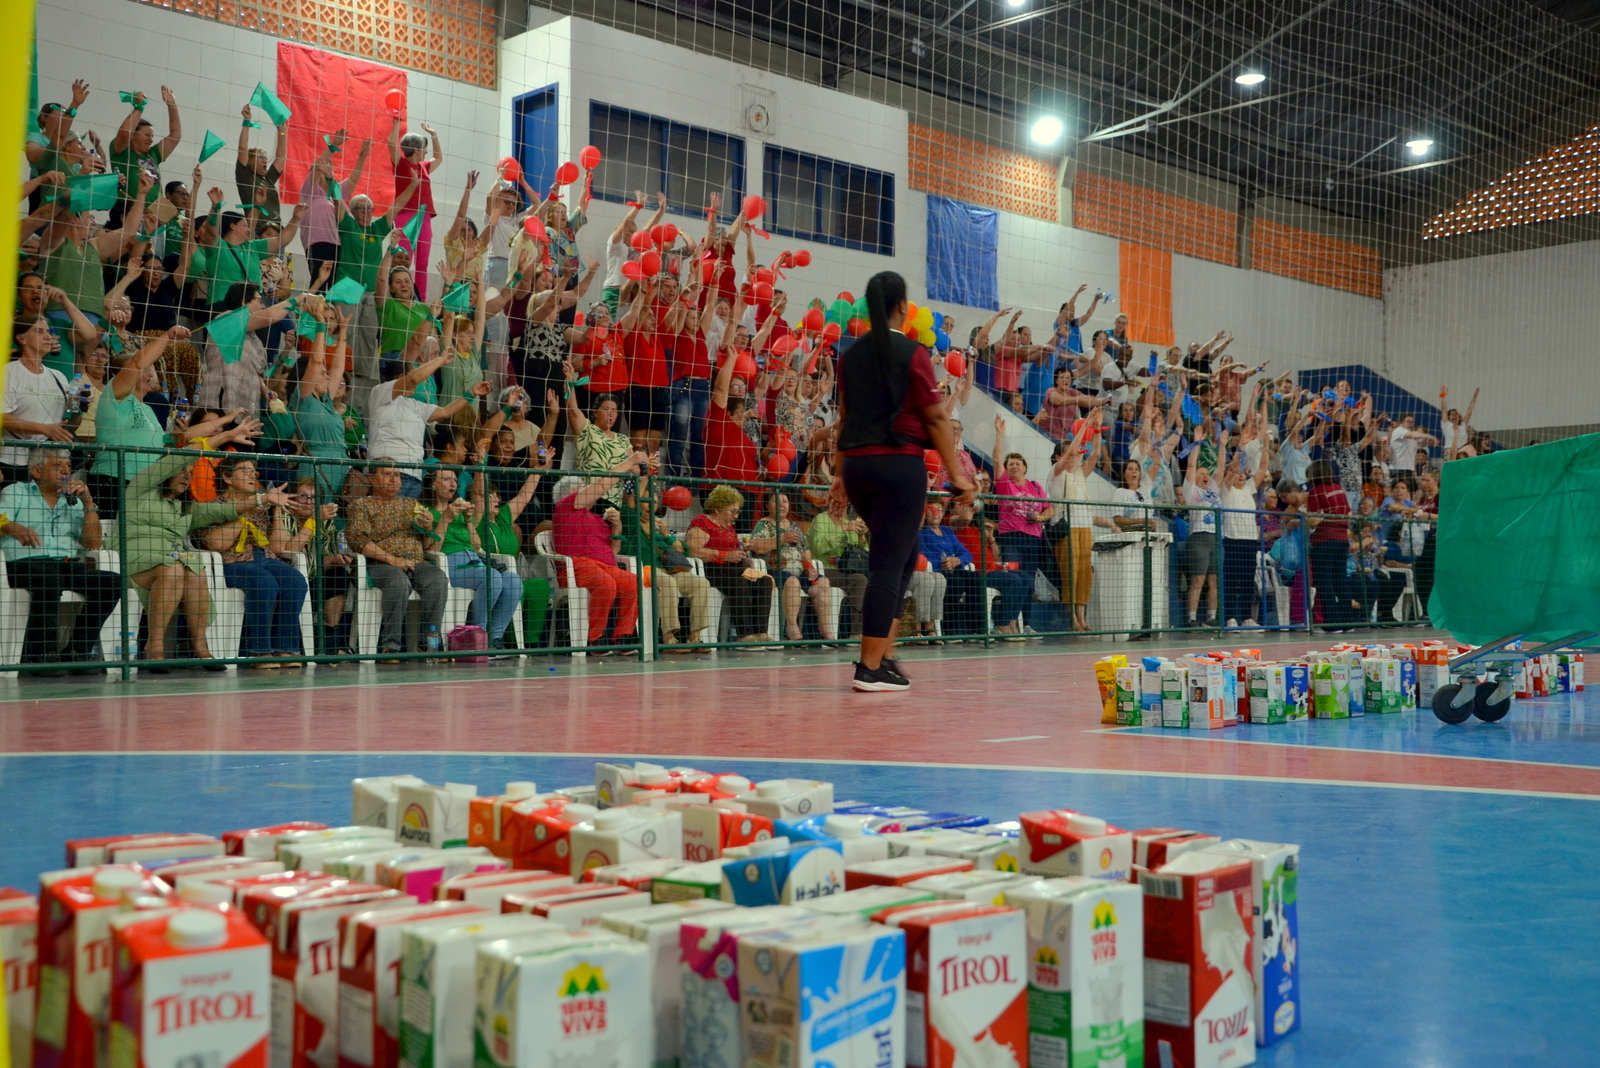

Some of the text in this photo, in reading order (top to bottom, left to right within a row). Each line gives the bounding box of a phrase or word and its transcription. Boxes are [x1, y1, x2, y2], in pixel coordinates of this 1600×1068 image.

[938, 954, 1019, 997] TIROL
[151, 991, 267, 1038] TIROL
[1201, 1003, 1249, 1044] TIROL
